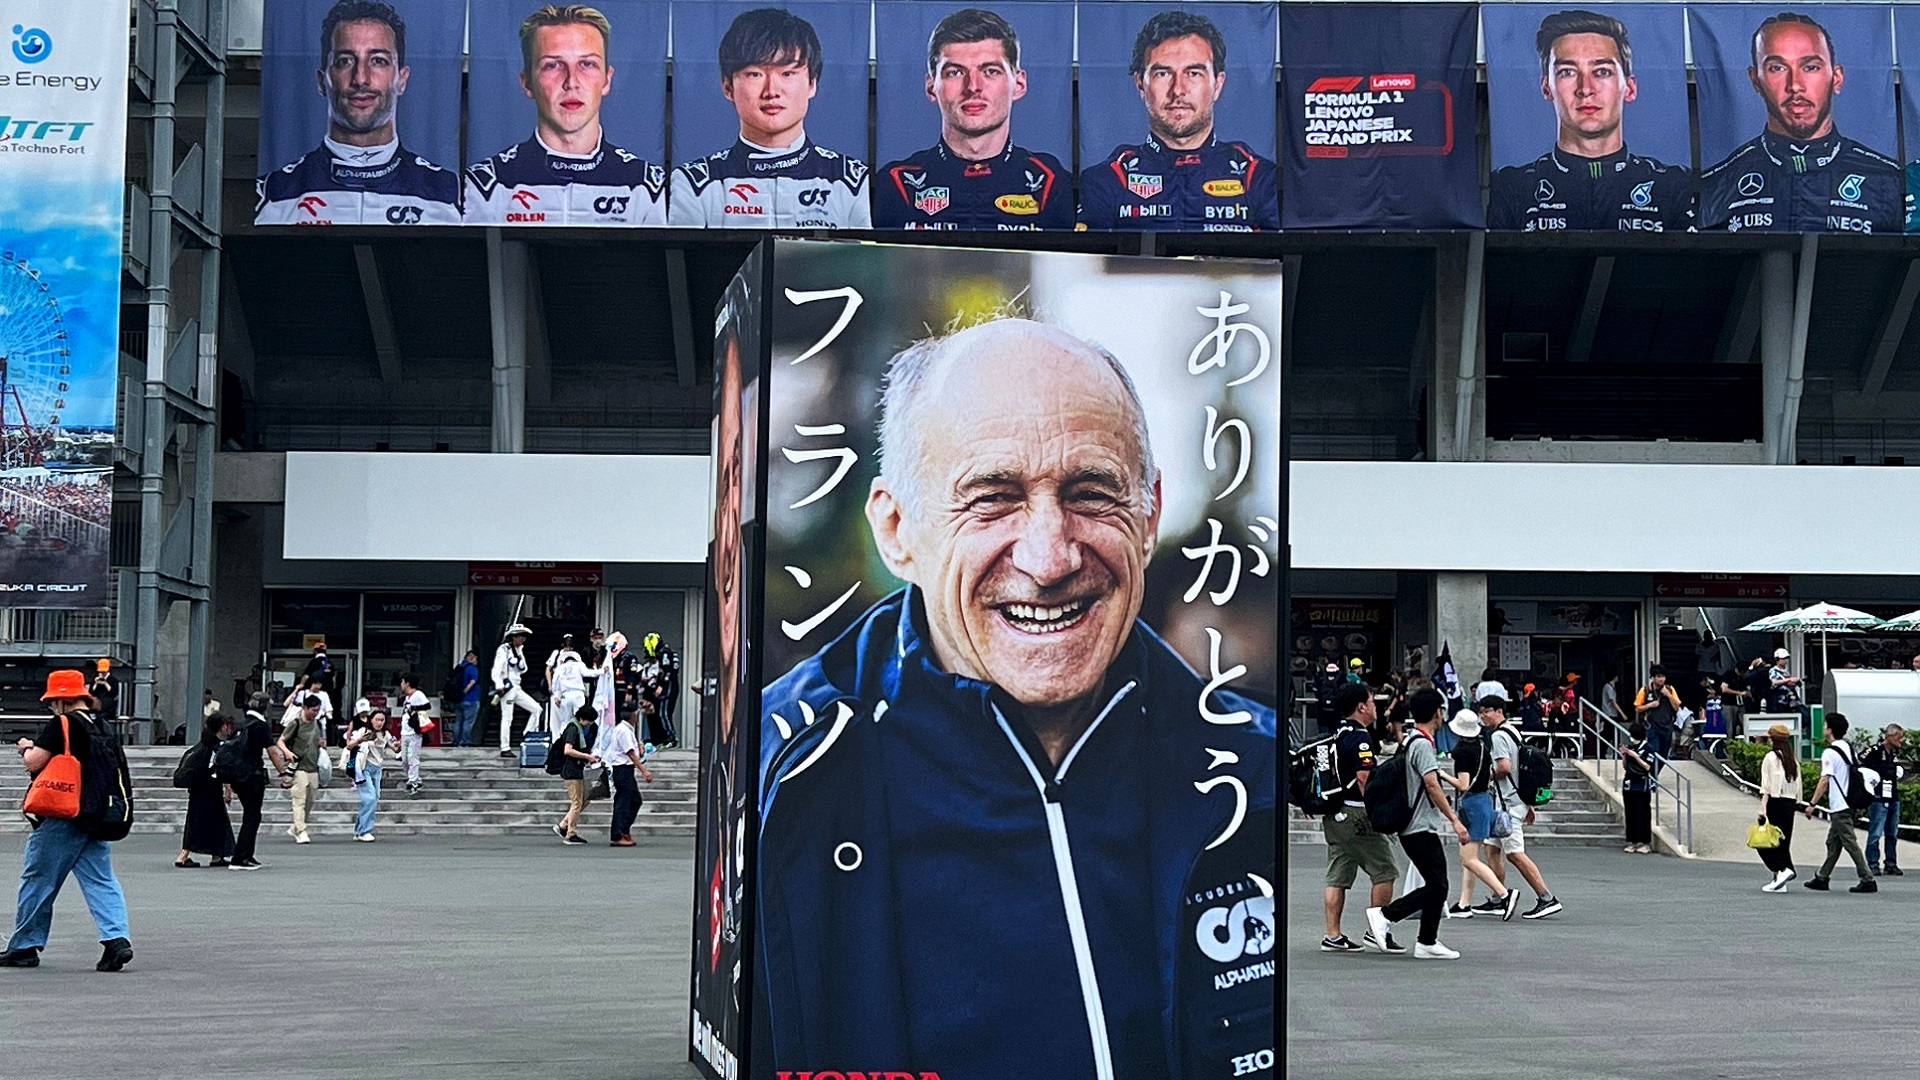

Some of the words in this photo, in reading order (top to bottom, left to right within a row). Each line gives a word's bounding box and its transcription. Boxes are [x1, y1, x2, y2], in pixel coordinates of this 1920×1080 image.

[16, 71, 102, 91] Energy
[1373, 78, 1411, 87] Lenovo
[1305, 92, 1391, 106] FORMULA
[1393, 91, 1404, 103] 1
[1305, 106, 1374, 119] LENOVO
[1305, 117, 1394, 132] JAPANESE
[1305, 132, 1368, 145] GRAND
[1370, 129, 1413, 143] PRIX
[11, 143, 57, 154] Techno
[60, 144, 85, 154] Fort
[724, 205, 763, 215] ORLEN
[1009, 200, 1038, 209] RAUC
[1119, 204, 1157, 218] Mobil
[1205, 203, 1249, 220] BYBIT
[506, 213, 545, 222] ORLEN
[1538, 217, 1567, 230] UBS
[1744, 213, 1773, 227] UBS
[1826, 215, 1872, 234] INEOS
[1203, 223, 1254, 232] HONDA
[1618, 218, 1664, 233] INEOS
[771, 286, 864, 872] フランツ。
[37, 583, 88, 592] CIRCUIT
[1181, 290, 1278, 898] ありがとう、
